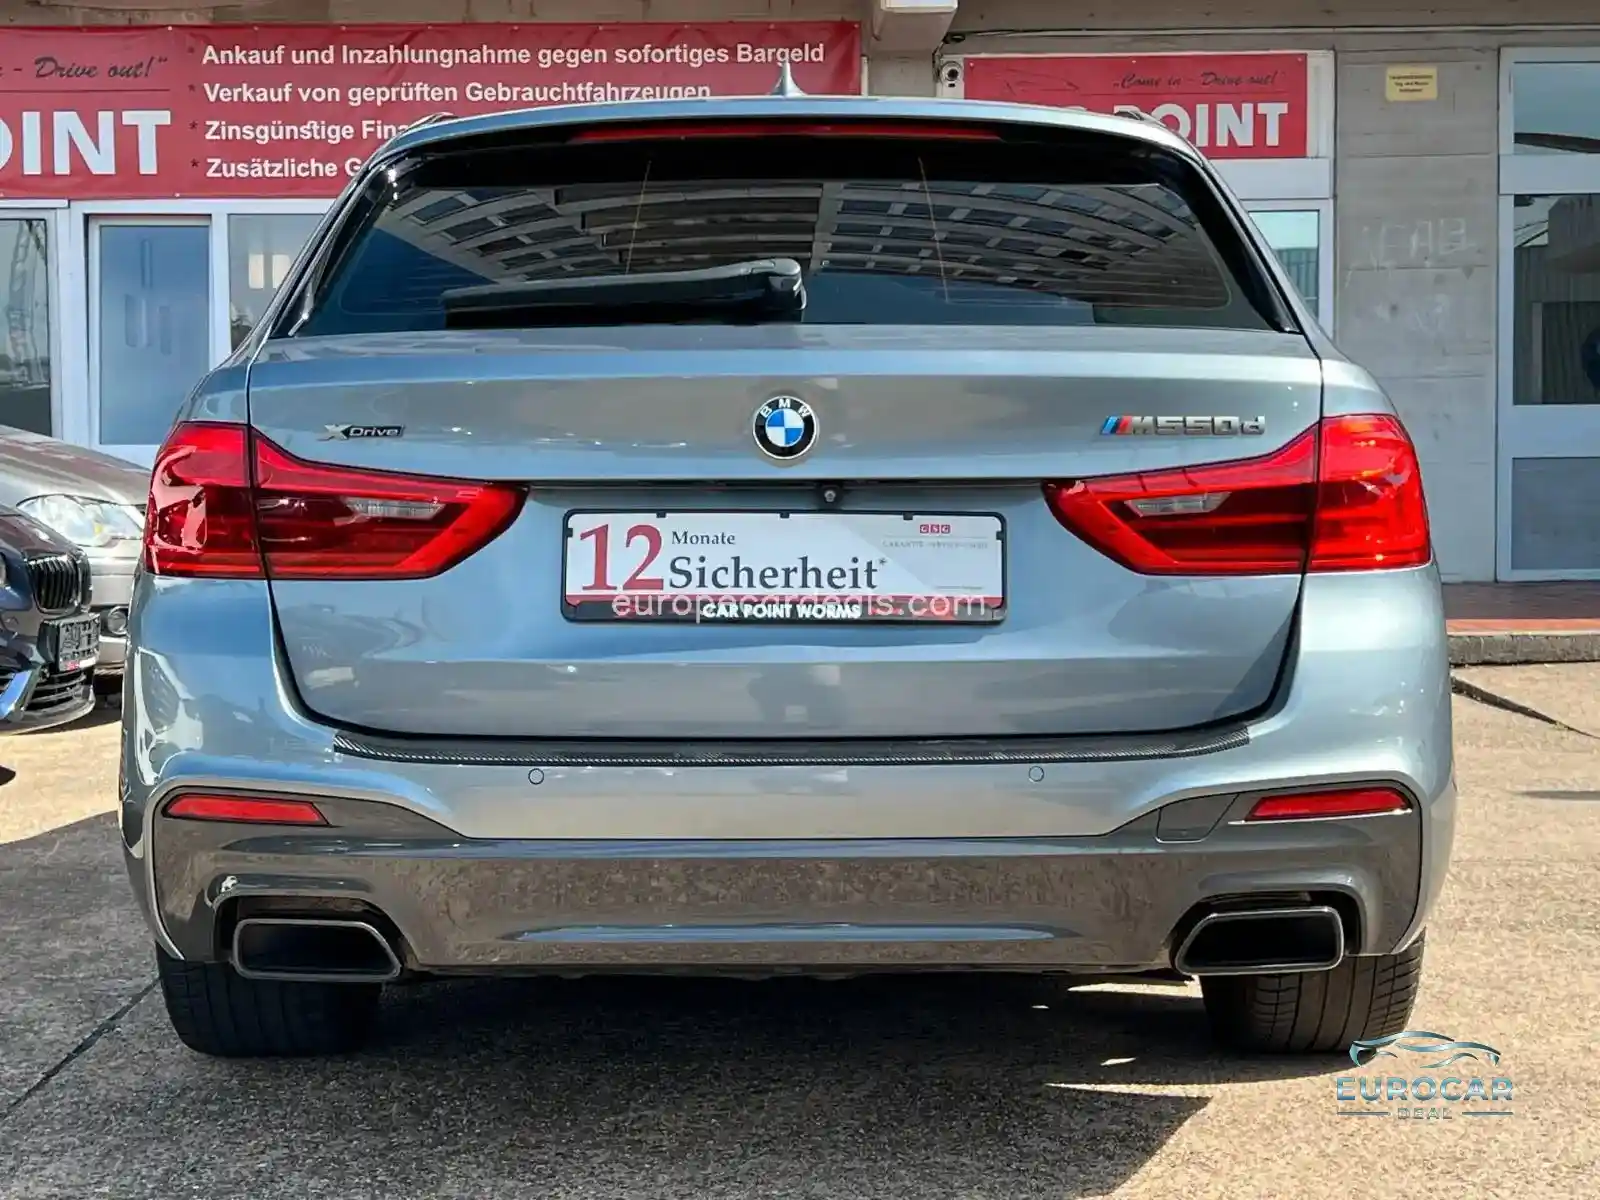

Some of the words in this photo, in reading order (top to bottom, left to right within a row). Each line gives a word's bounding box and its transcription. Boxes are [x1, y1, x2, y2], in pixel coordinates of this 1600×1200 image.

[34, 56, 99, 79] Drive
[202, 45, 285, 65] Ankauf
[291, 45, 334, 65] und
[342, 44, 531, 69] Inzahlungnahme
[537, 49, 608, 69] gegen
[614, 44, 730, 68] sofortiges
[736, 43, 825, 67] Bargeld
[1200, 71, 1243, 87] Drive
[203, 83, 293, 103] Verkauf
[298, 87, 341, 103] von
[347, 82, 458, 107] geprüften
[465, 81, 711, 103] Gebrauchtfahrzeugen
[0, 110, 172, 176] INT
[204, 120, 355, 144] Zinsgünstige
[206, 157, 338, 178] Zusätzliche
[760, 398, 812, 419] BMW
[671, 531, 736, 546] Monate
[579, 523, 665, 591] 12
[702, 602, 739, 619] CAR
[743, 602, 793, 619] POINT
[797, 602, 862, 620] WORMS
